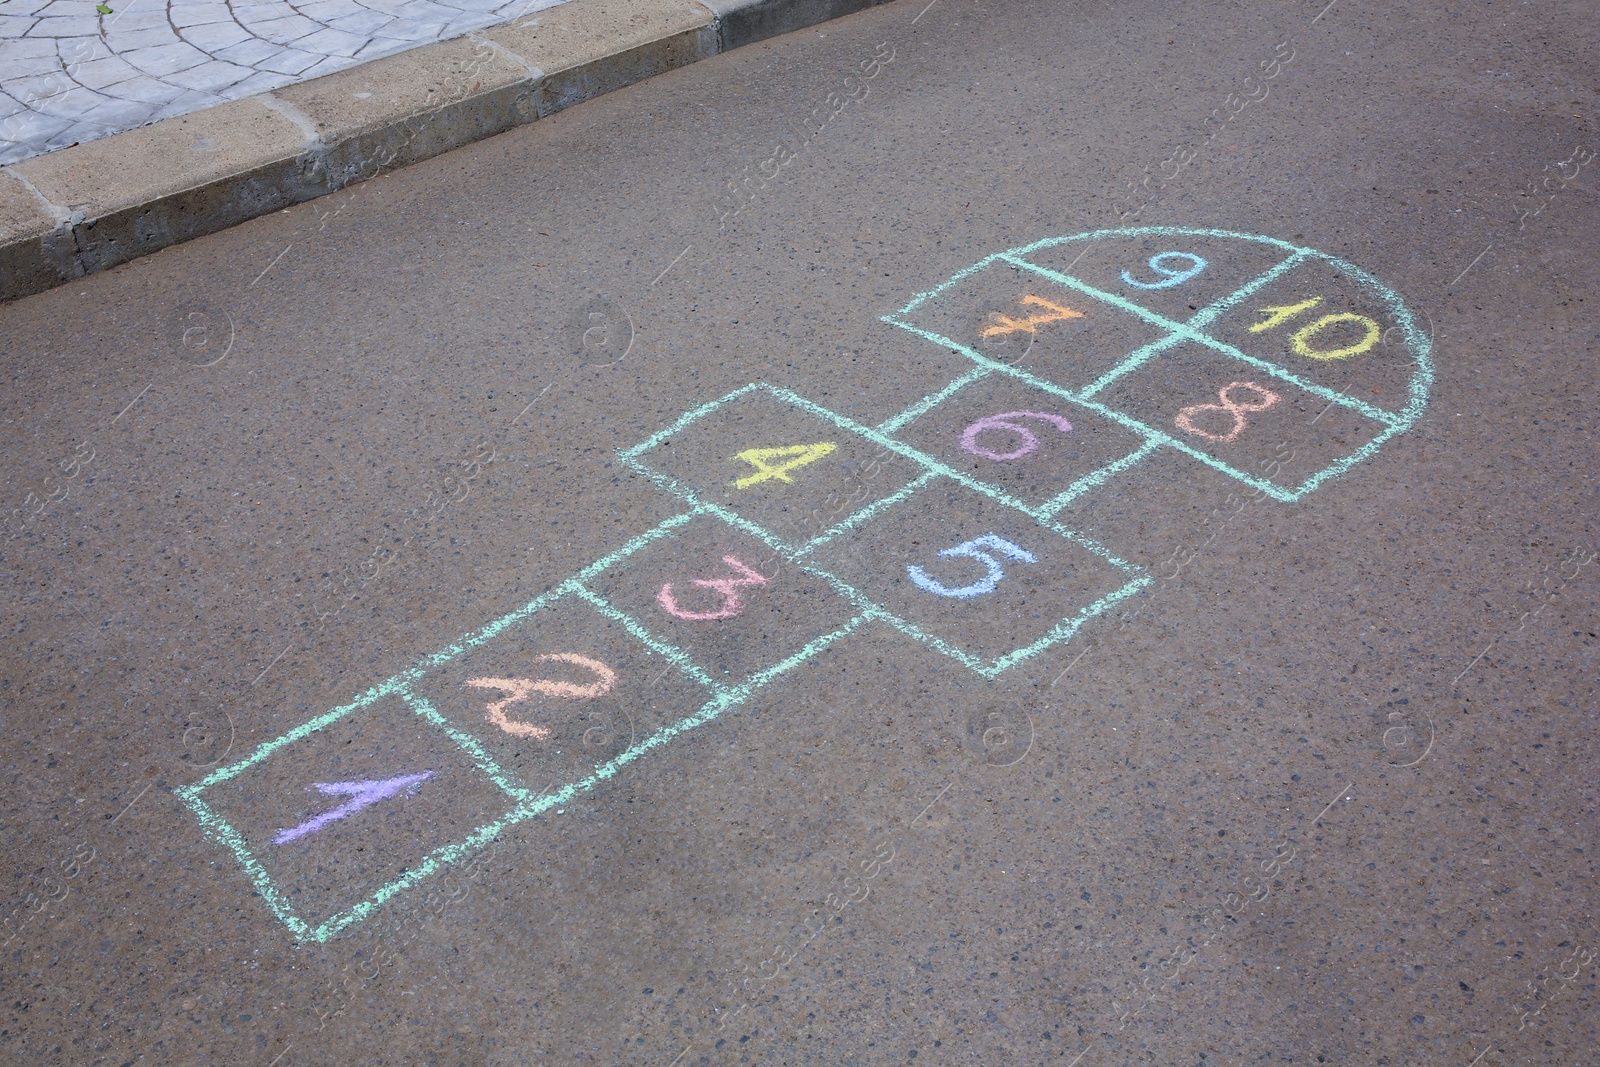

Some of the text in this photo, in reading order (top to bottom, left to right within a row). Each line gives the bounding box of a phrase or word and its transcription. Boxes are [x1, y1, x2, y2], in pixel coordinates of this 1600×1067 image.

[1121, 251, 1208, 290] 9
[979, 294, 1085, 338] 7
[1248, 295, 1381, 361] 10
[957, 410, 1073, 460] 6
[1174, 380, 1281, 442] 8
[731, 442, 837, 489] 4
[657, 555, 766, 619] 3
[907, 532, 1037, 599] 5
[463, 651, 617, 738] 2
[272, 770, 435, 845] 1
